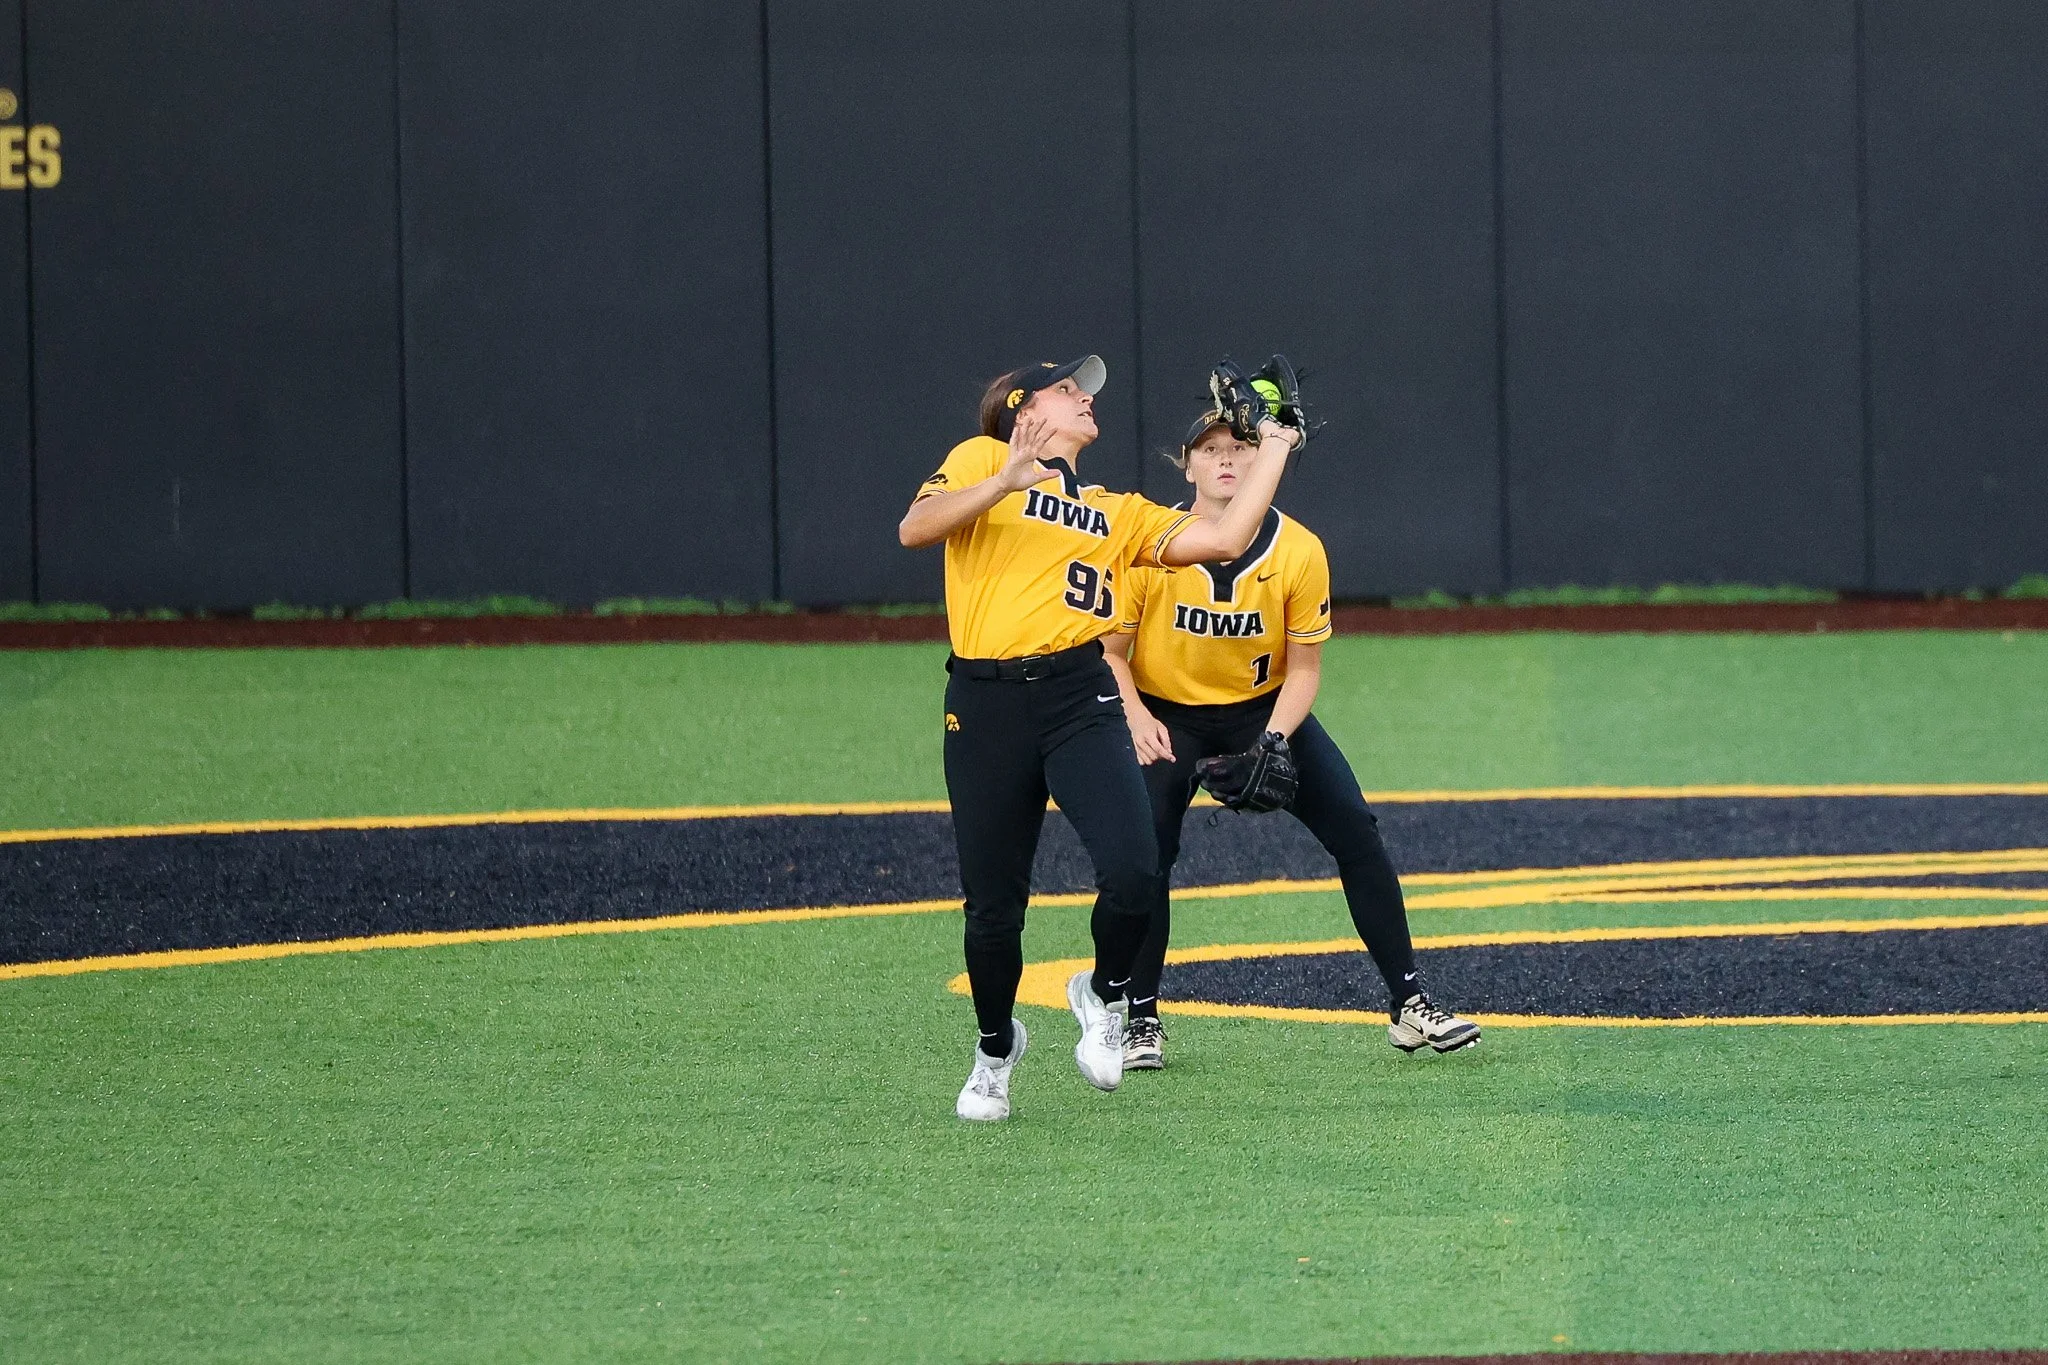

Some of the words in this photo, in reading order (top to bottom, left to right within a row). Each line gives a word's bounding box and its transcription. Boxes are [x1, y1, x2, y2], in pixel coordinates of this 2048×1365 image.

[1023, 488, 1110, 538] IOWA
[1174, 603, 1265, 637] IOWA
[1250, 652, 1272, 689] 1
